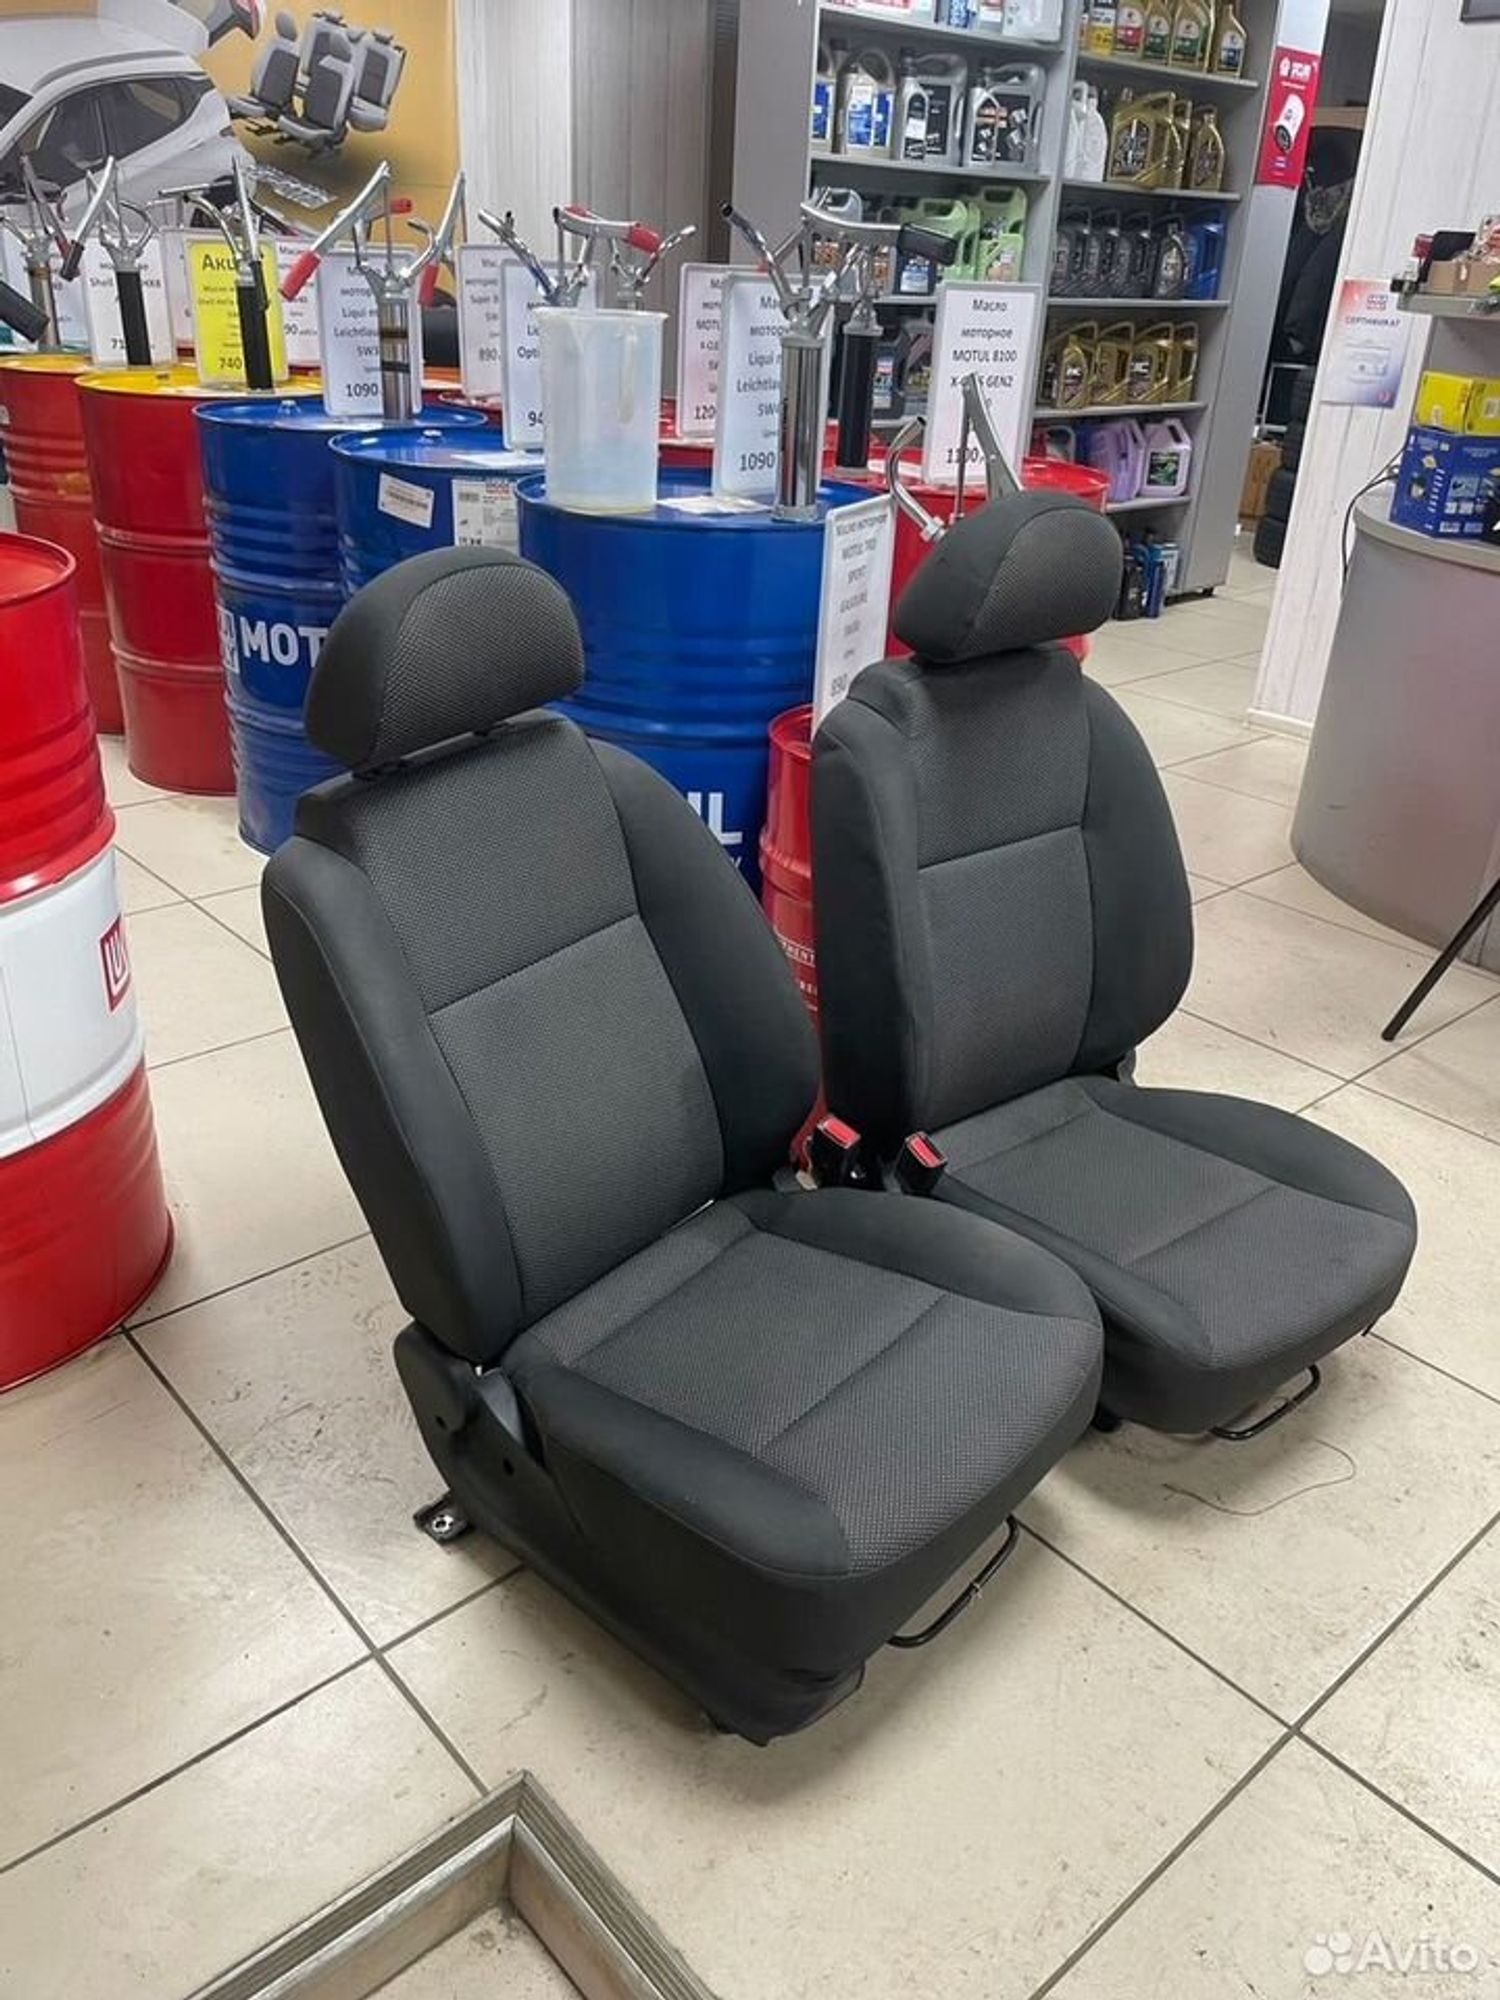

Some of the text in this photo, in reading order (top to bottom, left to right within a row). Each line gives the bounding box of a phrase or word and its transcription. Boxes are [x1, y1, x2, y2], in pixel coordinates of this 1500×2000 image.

[342, 306, 364, 319] Liqui
[972, 300, 1008, 313] Масло
[334, 326, 379, 339] Leichtlau
[961, 327, 1014, 343] моторное
[517, 345, 541, 361] Opti
[749, 352, 774, 367] Liqui
[952, 349, 991, 363] MOTUL
[345, 383, 379, 398] 1090
[739, 451, 775, 472] 1090
[239, 615, 329, 669] MOT
